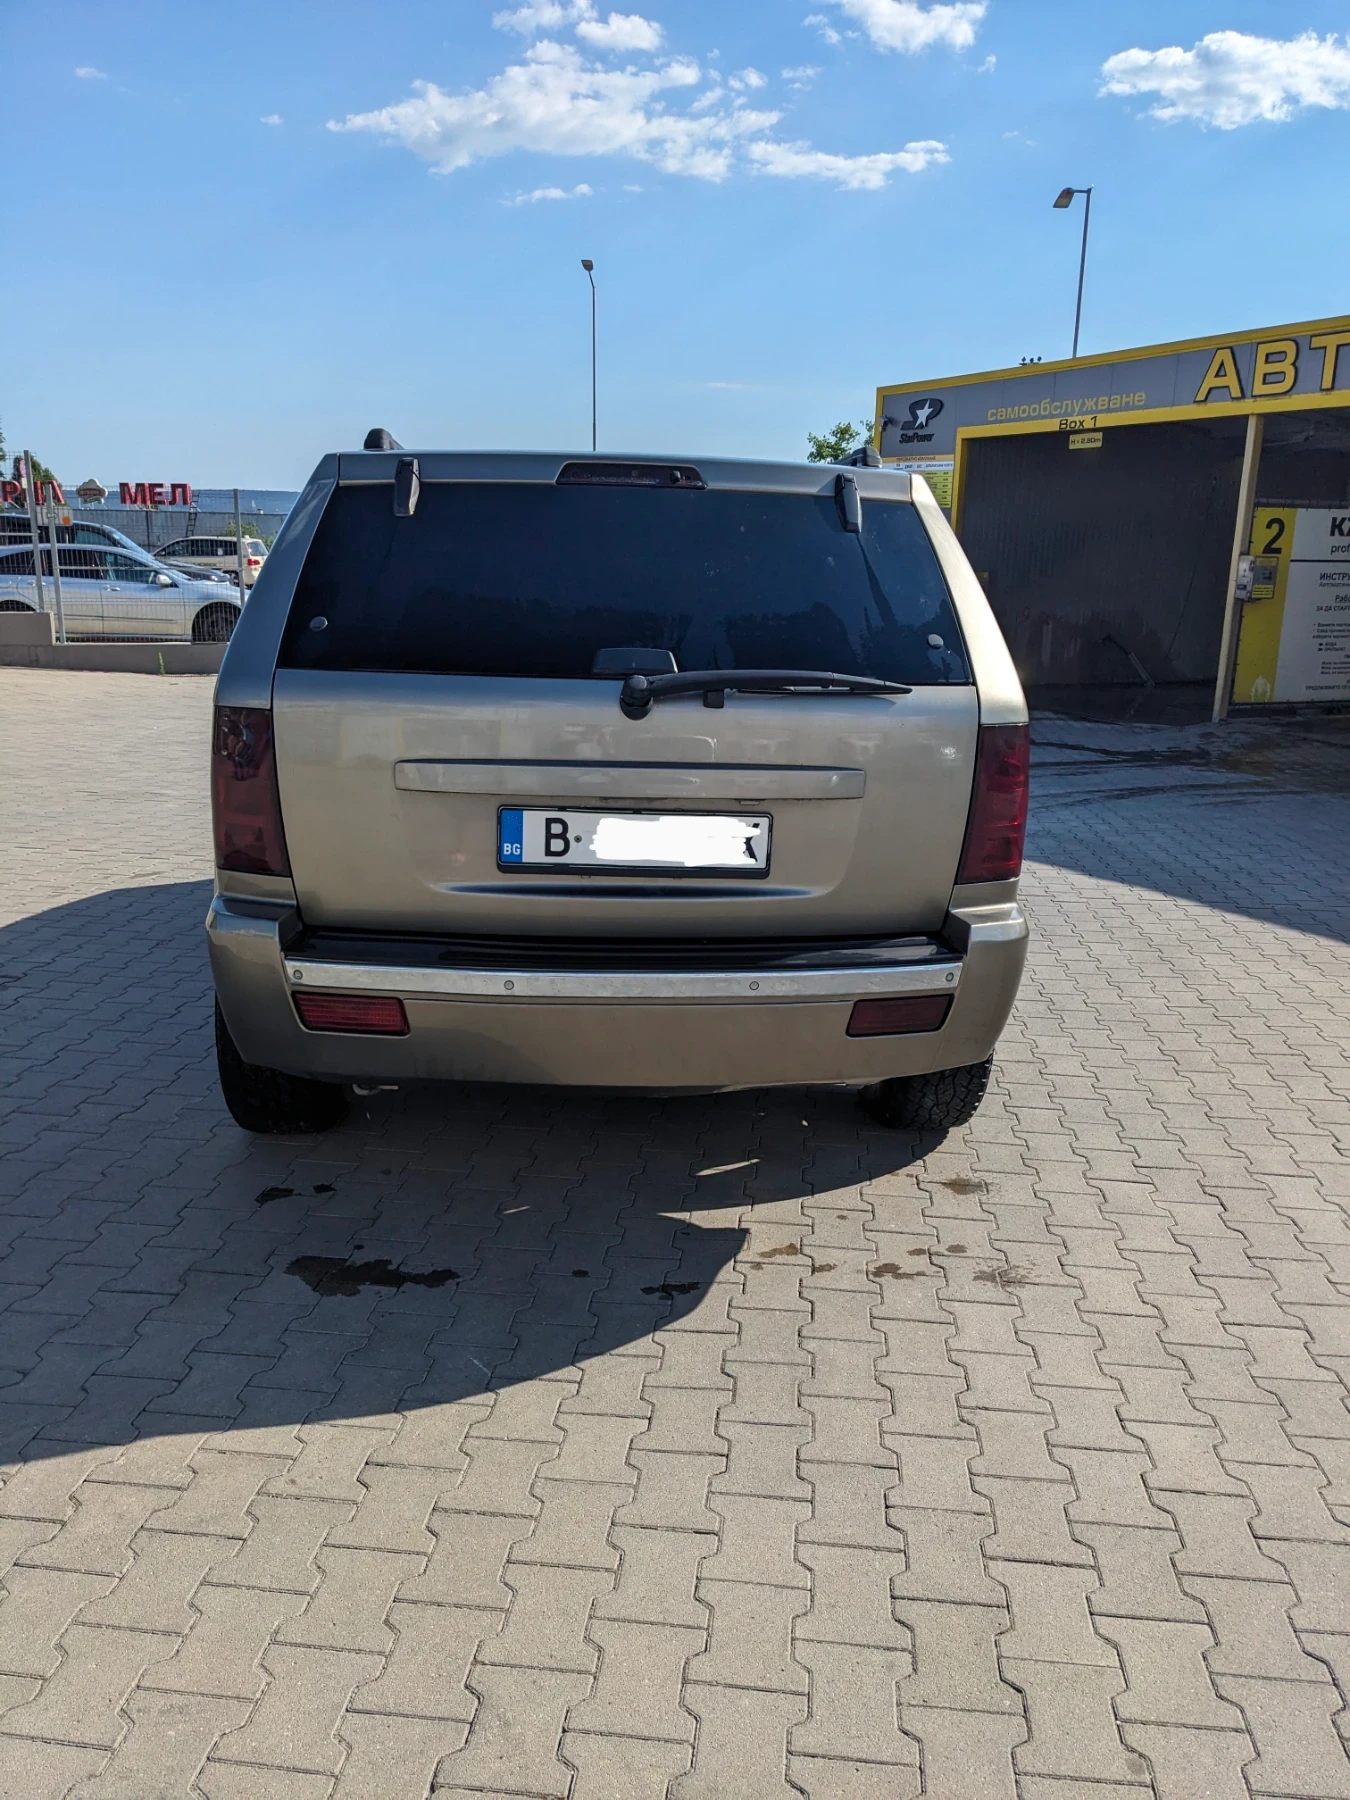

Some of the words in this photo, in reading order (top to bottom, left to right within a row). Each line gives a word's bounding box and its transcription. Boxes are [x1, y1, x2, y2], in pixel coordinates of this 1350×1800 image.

[1194, 330, 1350, 403] АВТ
[987, 391, 1146, 421] самообслужване
[1059, 418, 1085, 430] Box
[1090, 415, 1098, 428] 1
[899, 432, 935, 444] StarPower
[119, 482, 192, 505] МЕЛ
[1262, 517, 1286, 555] 2
[503, 843, 521, 855] BG
[544, 817, 571, 857] B
